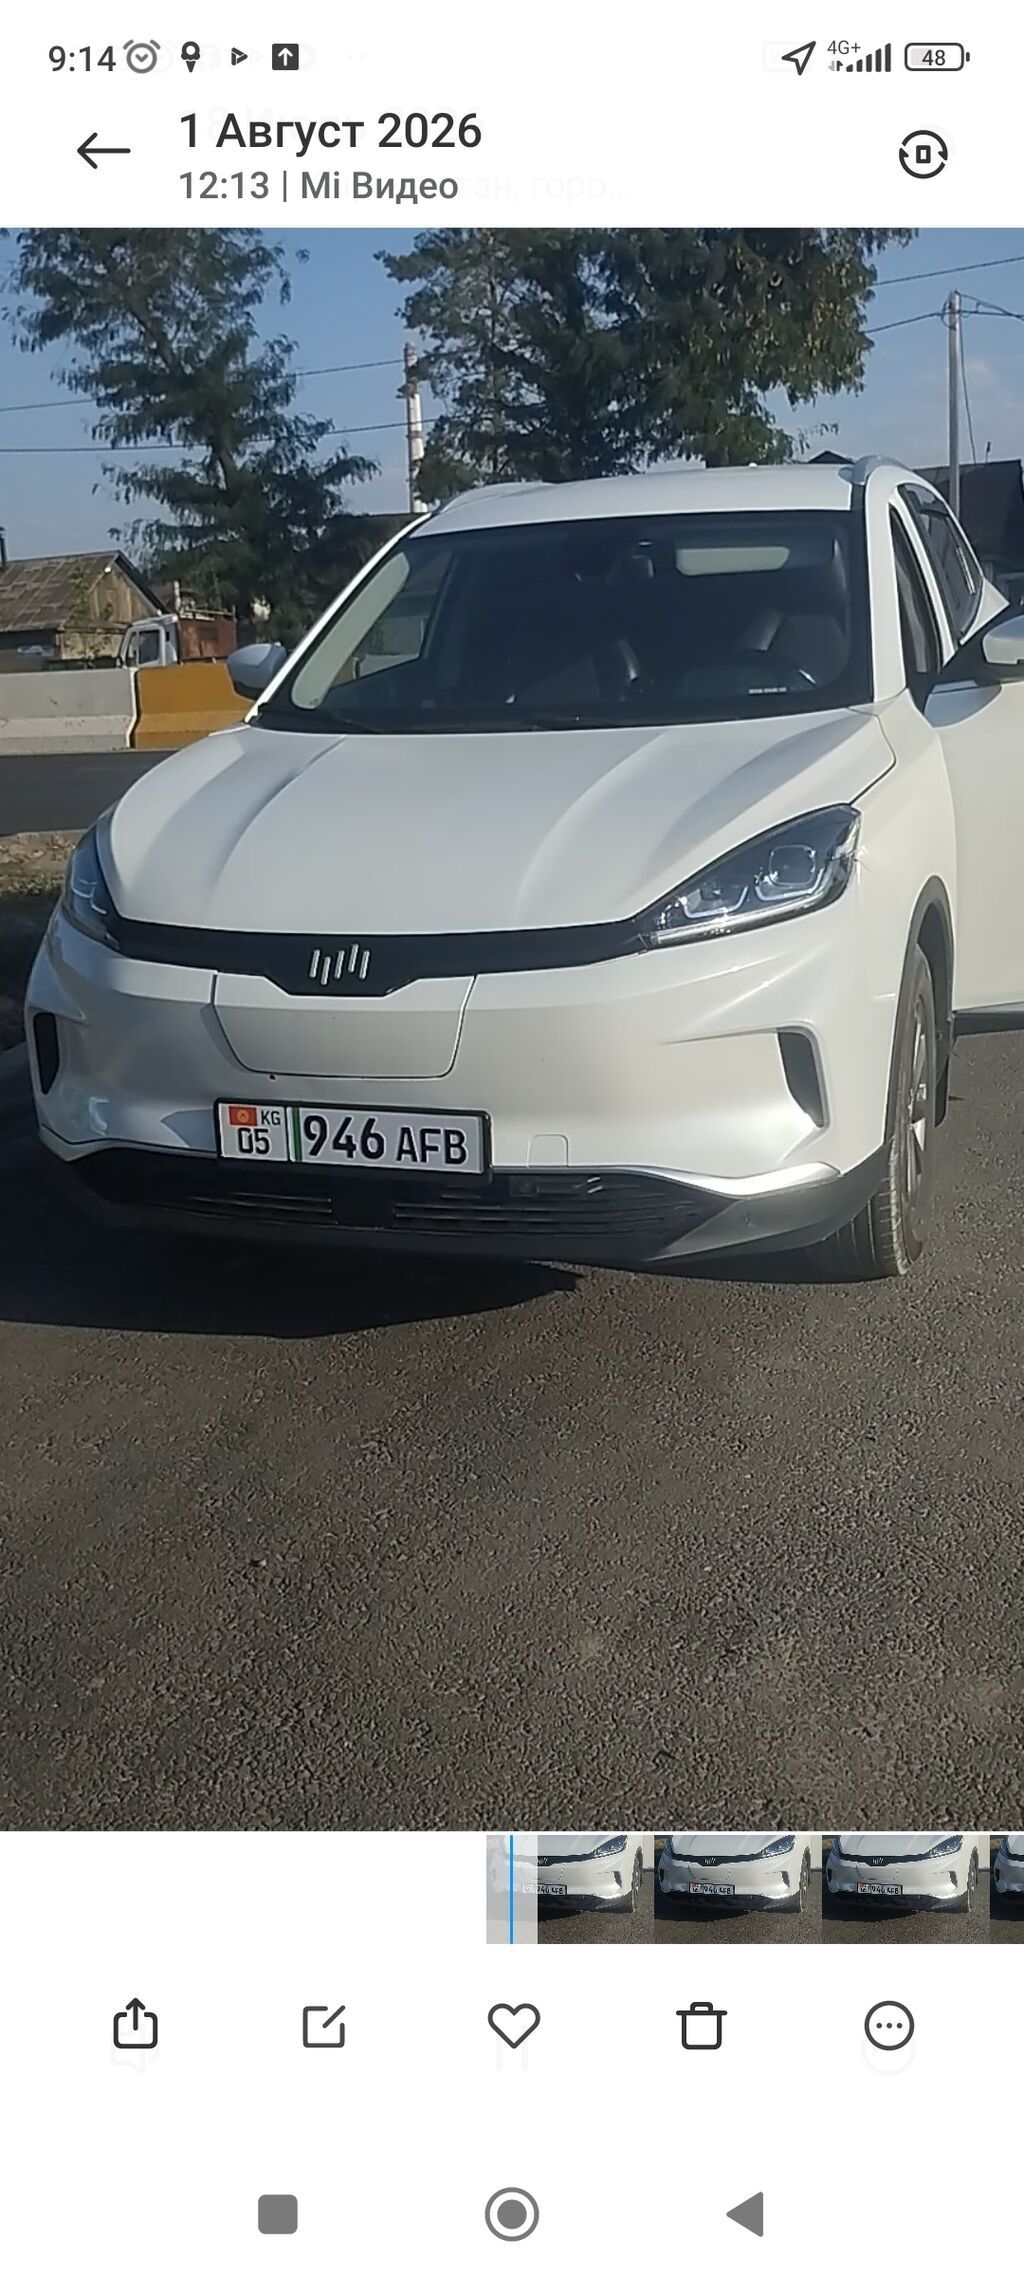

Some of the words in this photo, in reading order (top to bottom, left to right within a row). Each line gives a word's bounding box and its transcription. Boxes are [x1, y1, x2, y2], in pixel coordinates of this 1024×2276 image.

[260, 1110, 281, 1126] KG
[238, 1127, 270, 1155] 05
[303, 1114, 385, 1160] 946
[395, 1126, 468, 1165] AFB
